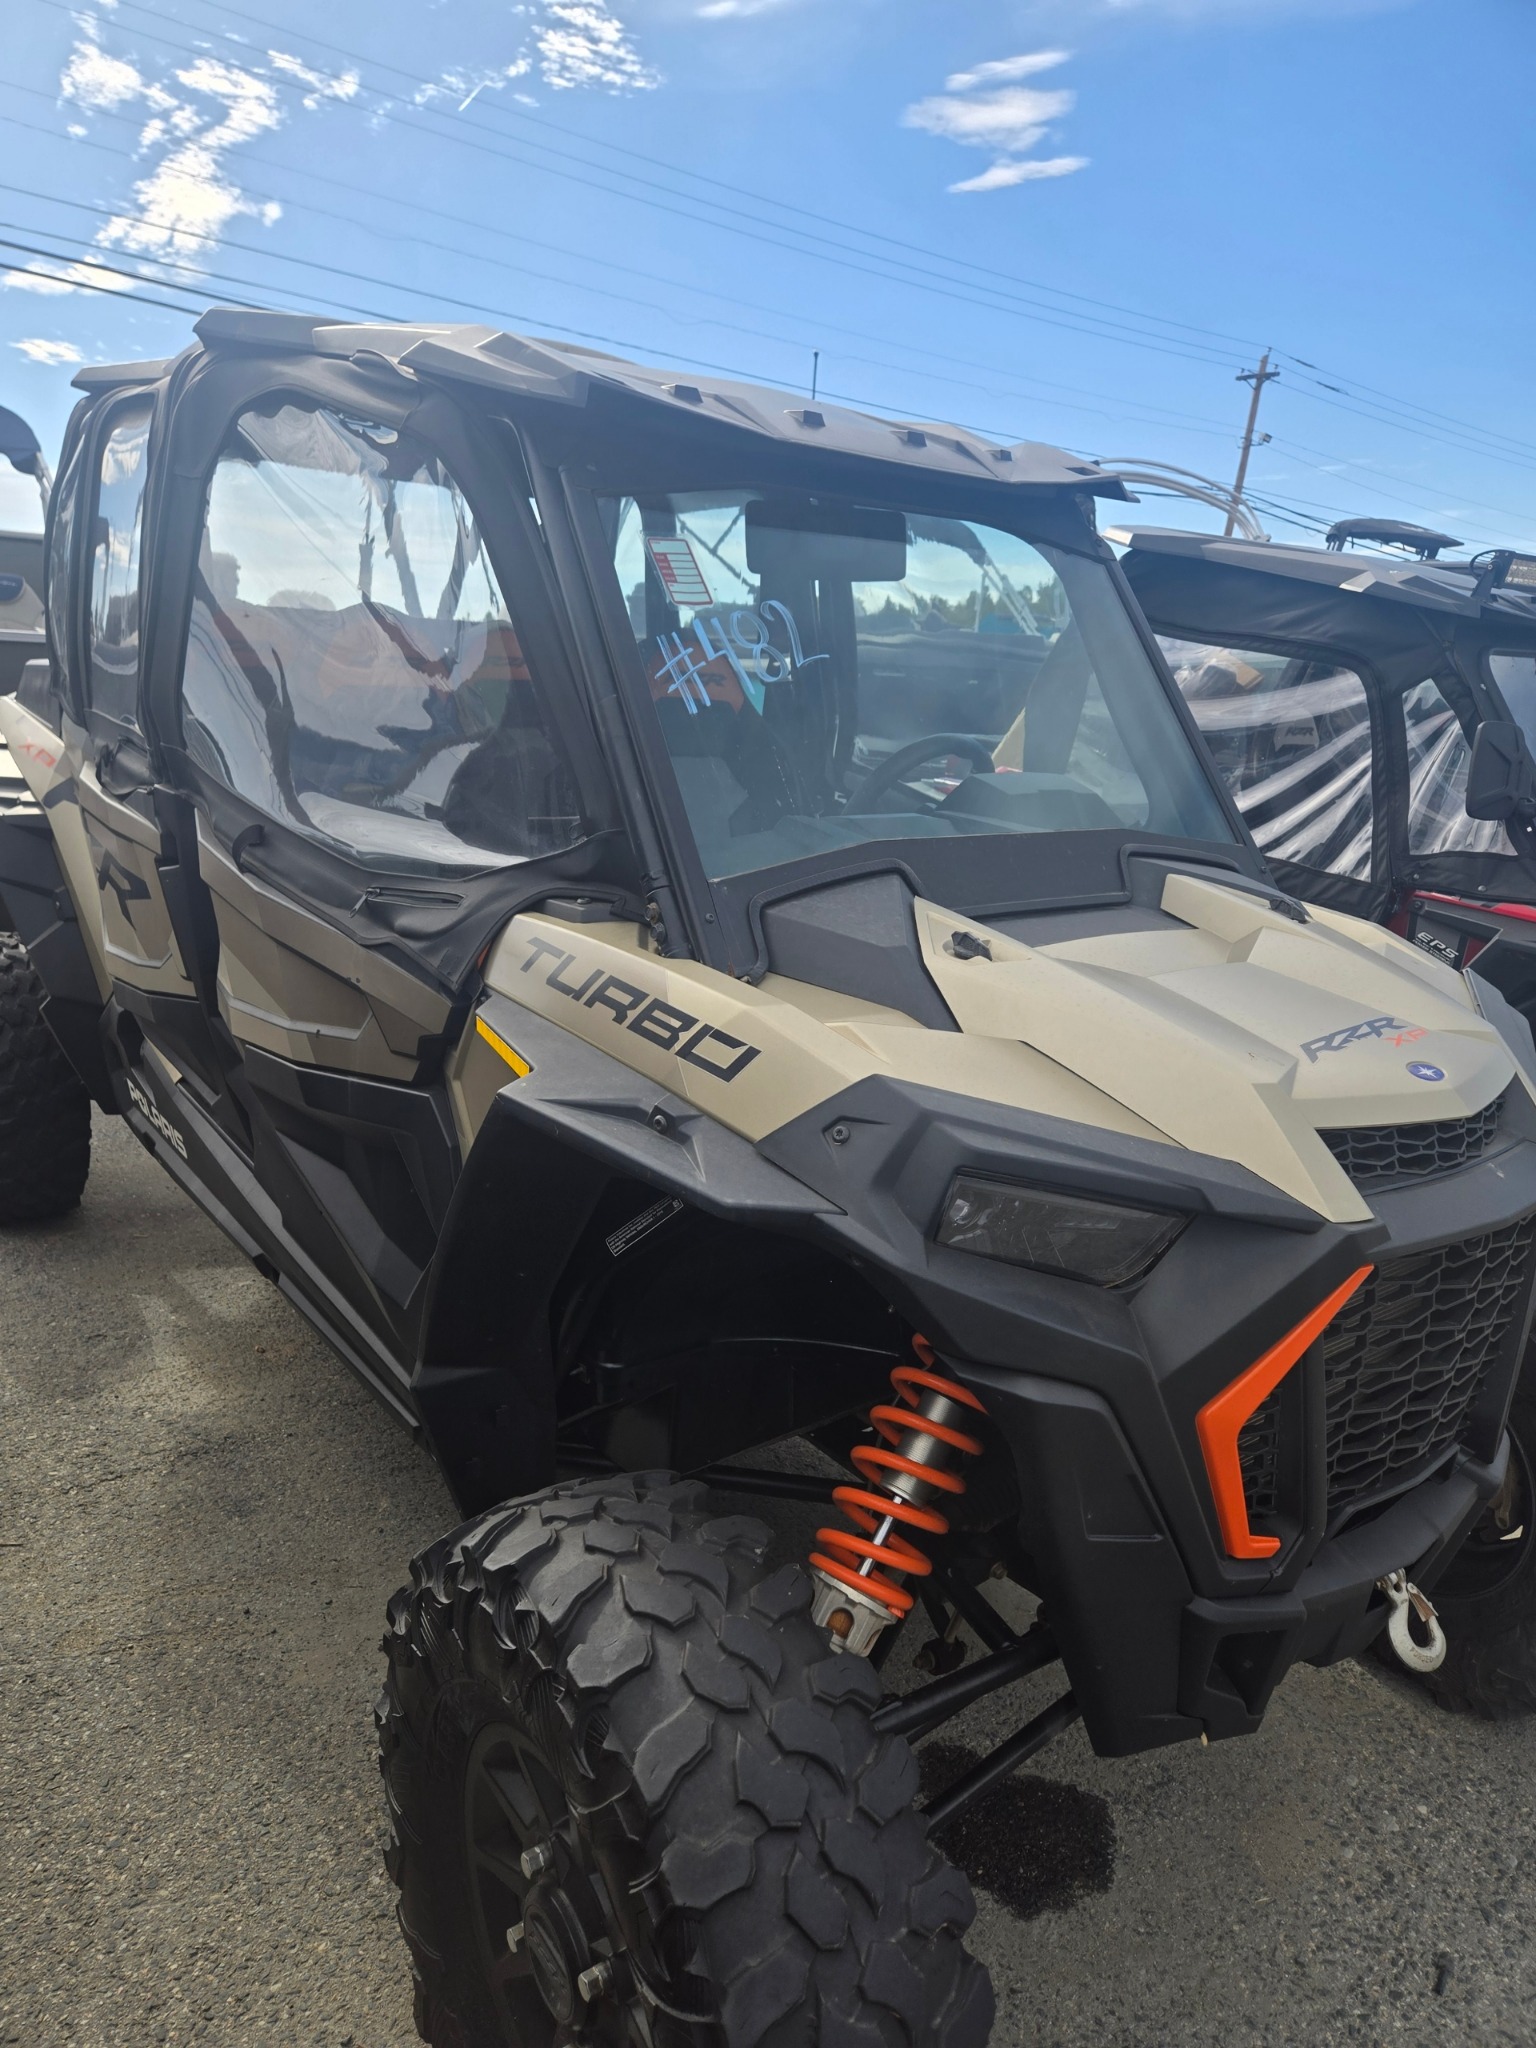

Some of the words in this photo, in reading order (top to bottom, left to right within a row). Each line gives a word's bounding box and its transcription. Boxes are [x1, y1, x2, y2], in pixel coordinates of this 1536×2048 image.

[654, 599, 830, 715] #482
[17, 736, 57, 769] XP
[1417, 931, 1459, 958] EPS
[520, 936, 762, 1083] TURBO
[1299, 1016, 1408, 1064] RZR
[1384, 1026, 1431, 1048] XP
[126, 1077, 188, 1160] POLARIS
